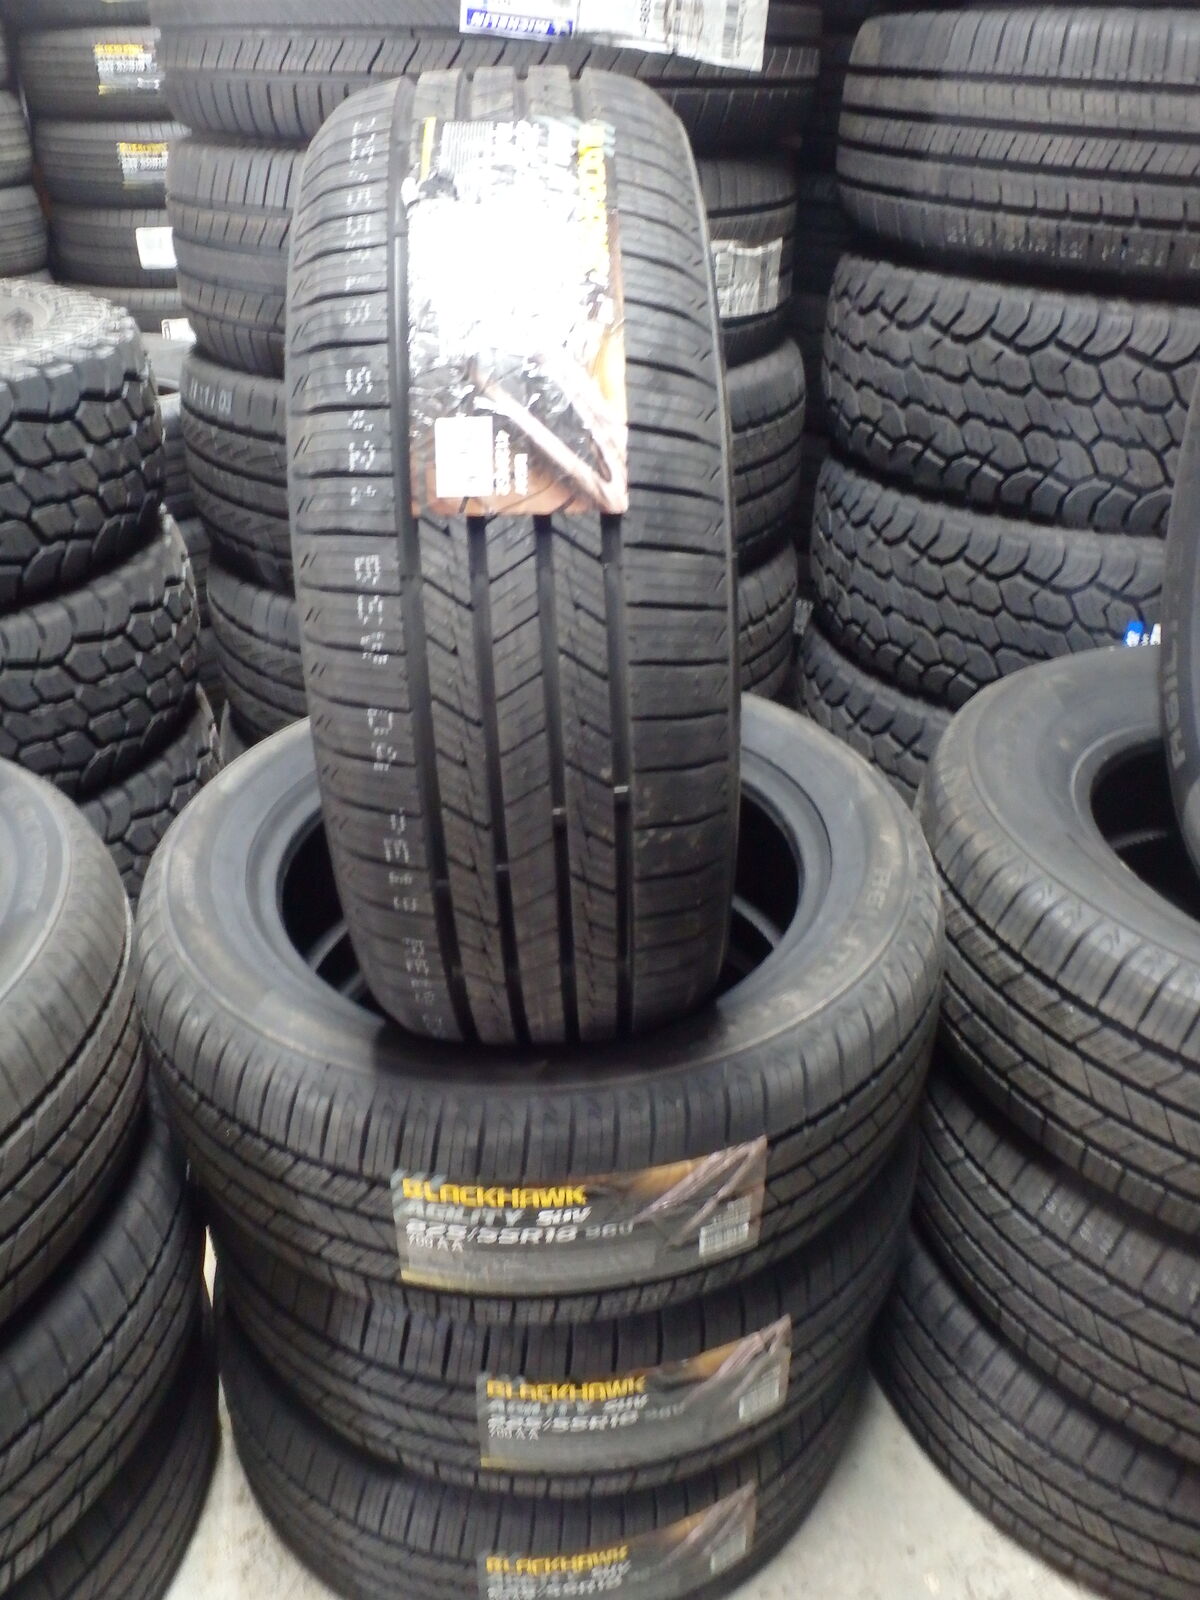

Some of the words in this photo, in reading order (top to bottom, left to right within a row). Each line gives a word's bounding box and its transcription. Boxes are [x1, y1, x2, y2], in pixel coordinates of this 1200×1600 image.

[470, 10, 552, 36] MICHELIN
[402, 1178, 587, 1208] BLACKHAWK
[487, 1374, 646, 1404] BLACKHAWK
[487, 1545, 628, 1577] BLACKHAWK
